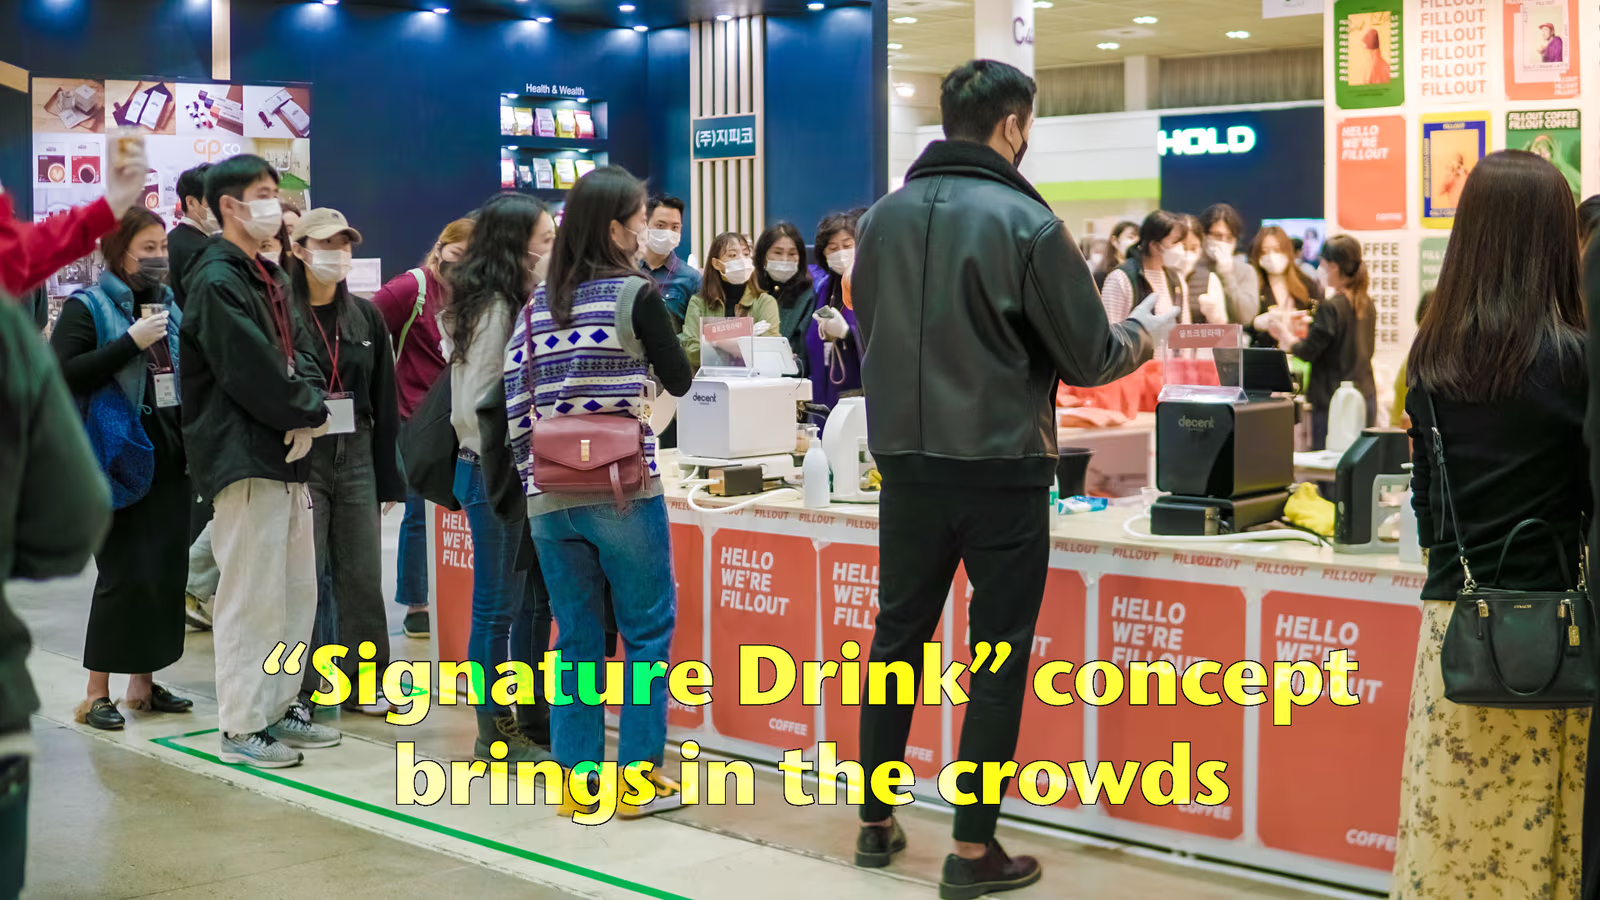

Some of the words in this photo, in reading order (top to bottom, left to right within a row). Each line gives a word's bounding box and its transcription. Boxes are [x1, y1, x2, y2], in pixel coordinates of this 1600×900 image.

[1421, 9, 1486, 26] FILLOUT
[1421, 26, 1486, 43] FILLOUT
[1421, 44, 1486, 61] FILLOUT
[1421, 62, 1487, 79] FILLOUT
[525, 83, 551, 94] Health
[551, 84, 558, 94] &
[559, 85, 585, 96] Wealth
[1422, 80, 1487, 96] FILLOUT
[695, 126, 754, 149] (주)지피코
[1342, 125, 1379, 136] HELLO
[1157, 125, 1257, 156] HOLD
[1342, 137, 1378, 148] WE'RE
[1342, 147, 1389, 160] FILLOUT
[692, 391, 717, 403] decent
[1177, 415, 1215, 428] decent
[754, 508, 790, 520] FILLOUT
[799, 513, 836, 525] FILLOUT
[845, 518, 878, 530] FILLOU
[720, 546, 774, 570] HELLO
[1054, 541, 1099, 555] FILLOUT
[1112, 547, 1159, 561] FILLOUT
[1255, 561, 1308, 576] FILLOUT
[1322, 567, 1376, 584] FILLOUT
[721, 568, 772, 592] WE'RE
[720, 589, 789, 616] FILLOUT
[1111, 596, 1186, 625] HELLO
[1112, 621, 1184, 650] WE'RE
[1275, 613, 1359, 646] HELLO
[1111, 646, 1209, 679] FILLOUT
[769, 718, 808, 736] COFFEE
